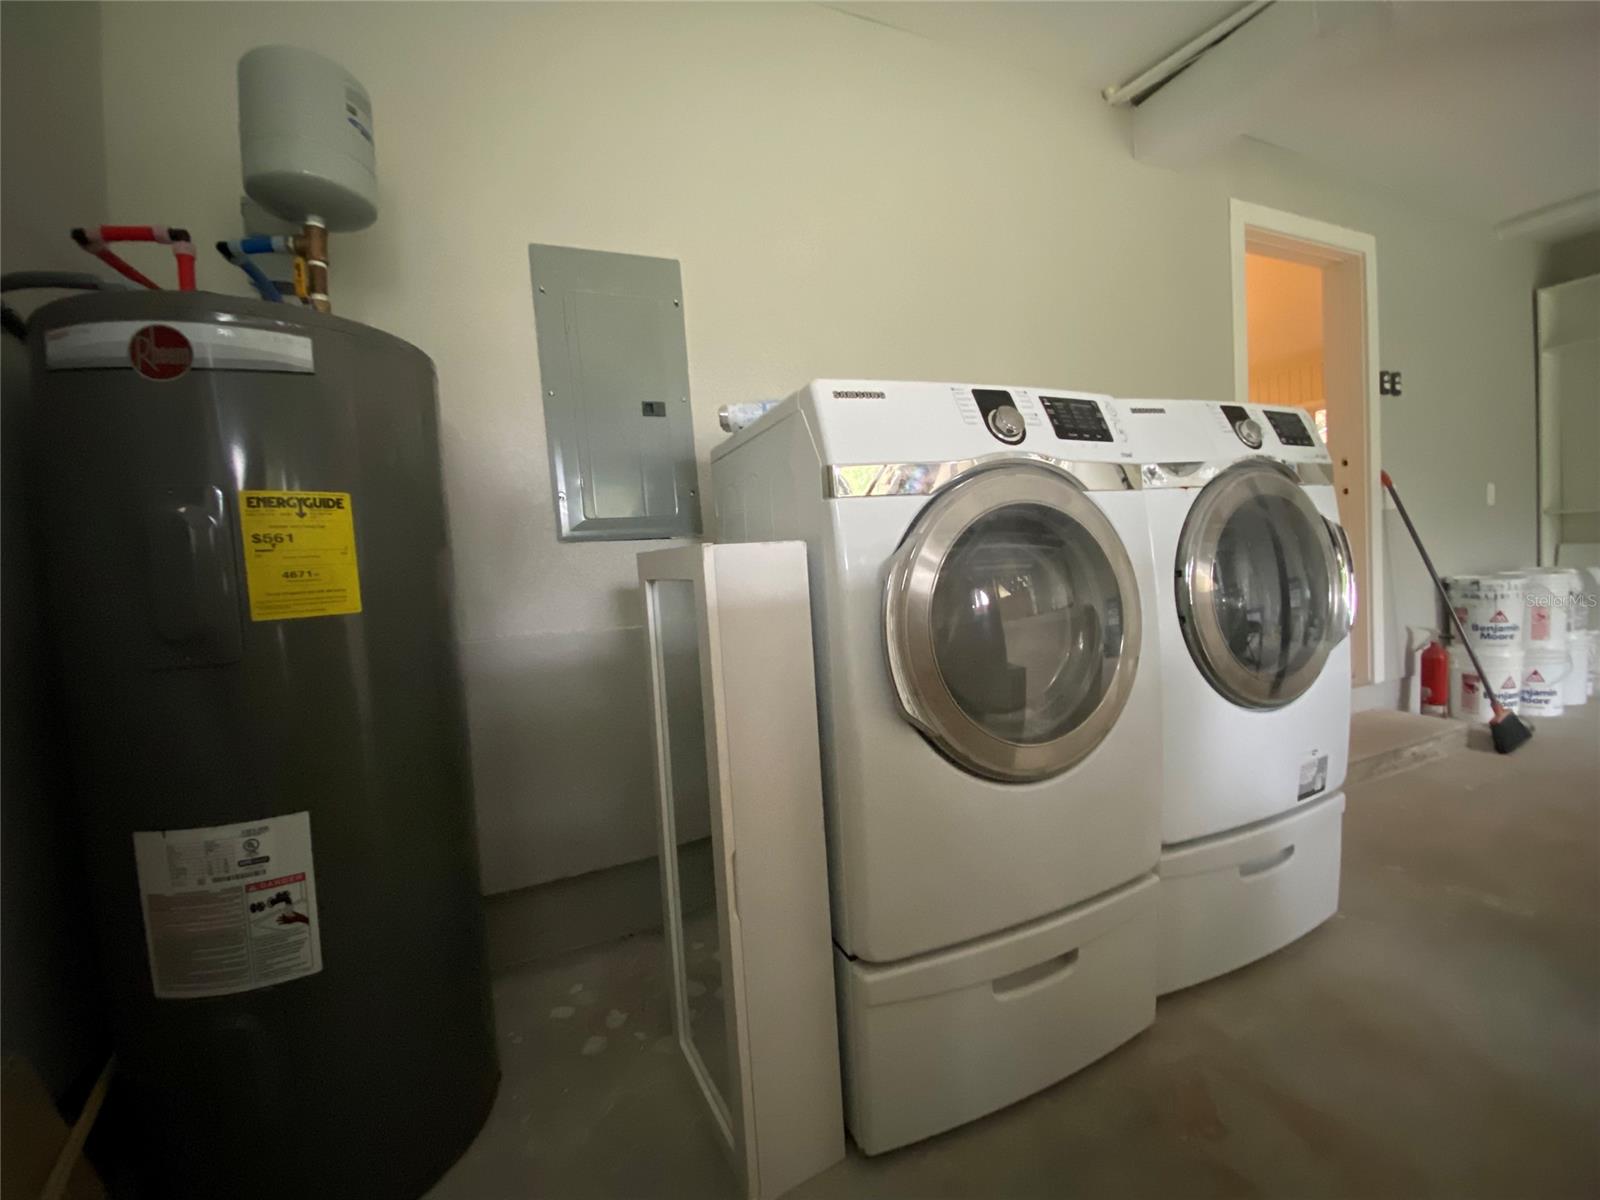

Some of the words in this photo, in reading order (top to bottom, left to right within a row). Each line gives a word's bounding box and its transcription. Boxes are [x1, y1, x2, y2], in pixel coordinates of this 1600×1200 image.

[832, 390, 886, 400] SAMSUNG
[251, 533, 294, 544] $561
[1471, 623, 1520, 634] Benjamin
[1479, 632, 1515, 640] Moore
[1520, 689, 1557, 698] njamin
